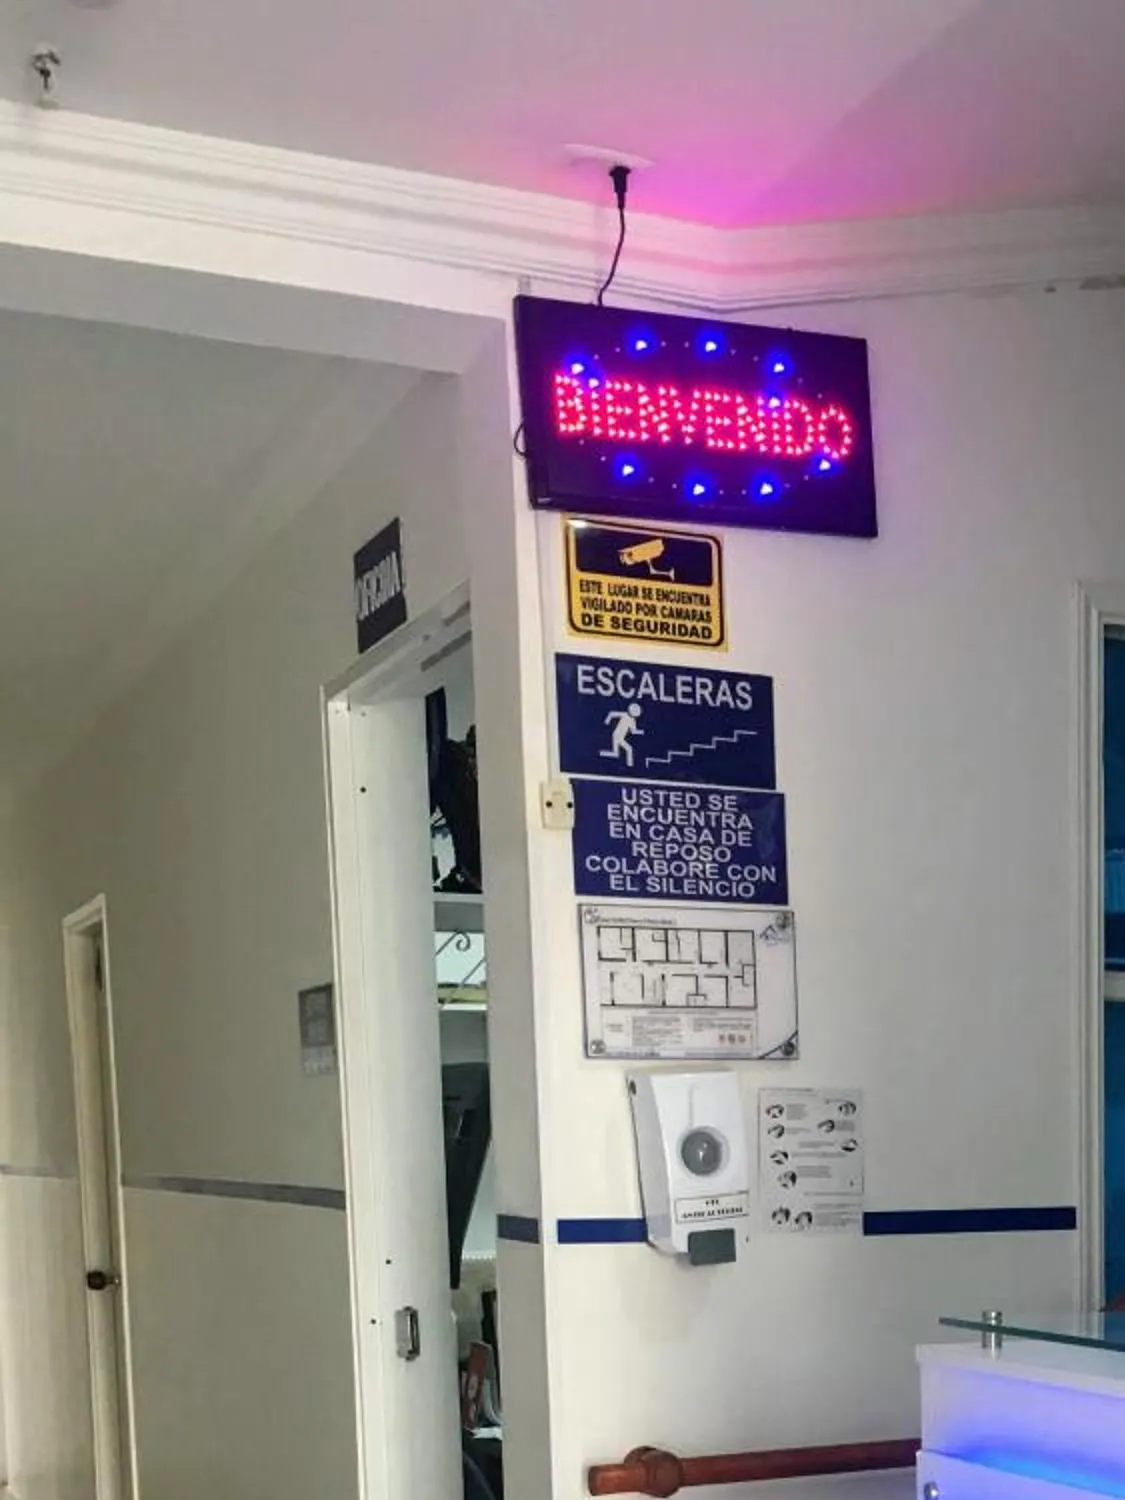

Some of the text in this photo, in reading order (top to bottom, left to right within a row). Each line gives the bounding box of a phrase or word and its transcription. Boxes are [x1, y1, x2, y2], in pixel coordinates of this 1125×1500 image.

[554, 372, 854, 460] BIENVENIDO
[580, 579, 710, 606] ESTE LUGAR SE ENCUENTRA
[580, 597, 712, 623] VIGILADO POR CAMARAS
[581, 613, 712, 639] DE SEGURIDAD
[577, 664, 753, 711] ESCALERAS
[622, 788, 738, 812] USTED SE
[607, 803, 753, 830] ENCUENTRA
[609, 822, 752, 847] EN CASA DE
[632, 842, 731, 863] REPOSO
[585, 855, 776, 883] COLABORE CON
[610, 875, 755, 898] EL SILENCIO
